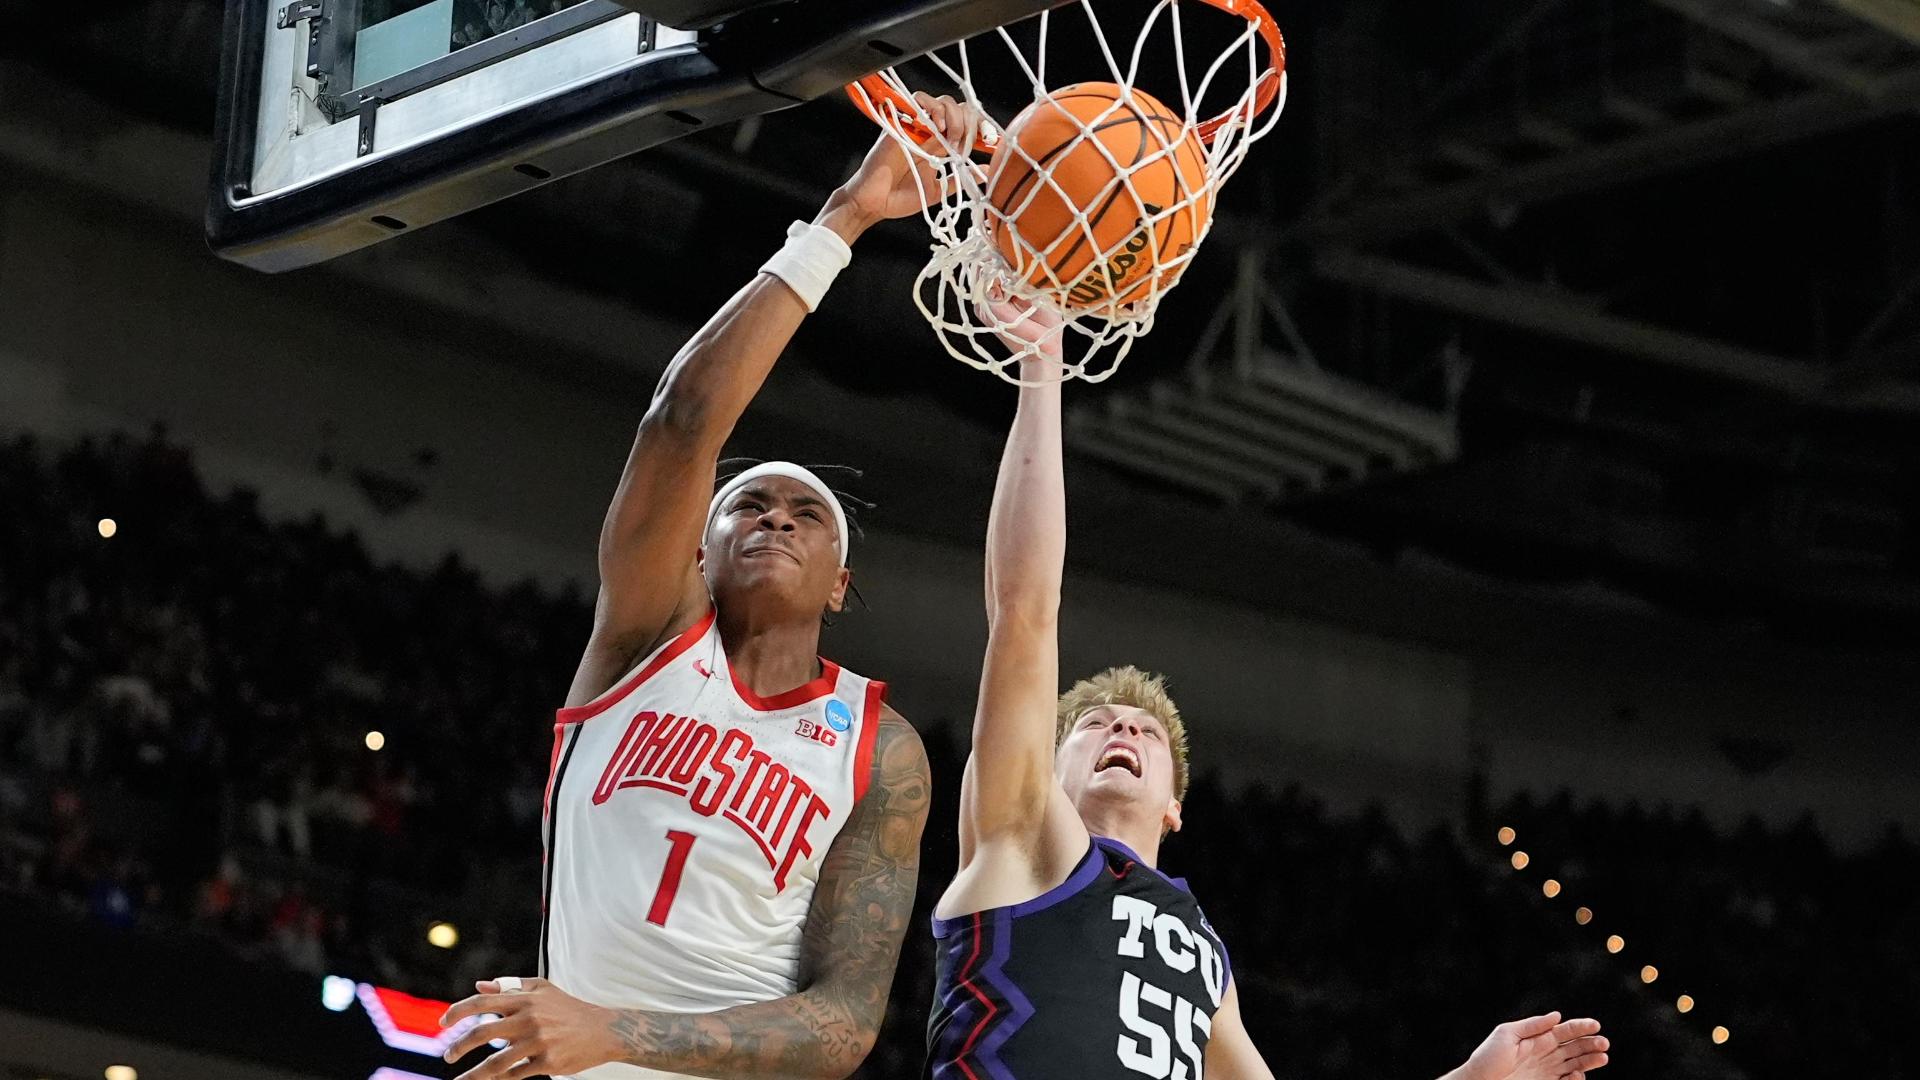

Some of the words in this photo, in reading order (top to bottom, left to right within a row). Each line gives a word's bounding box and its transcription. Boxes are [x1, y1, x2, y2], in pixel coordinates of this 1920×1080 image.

[645, 829, 697, 928] 1
[1112, 894, 1224, 1008] TCU
[1117, 970, 1212, 1079] 55
